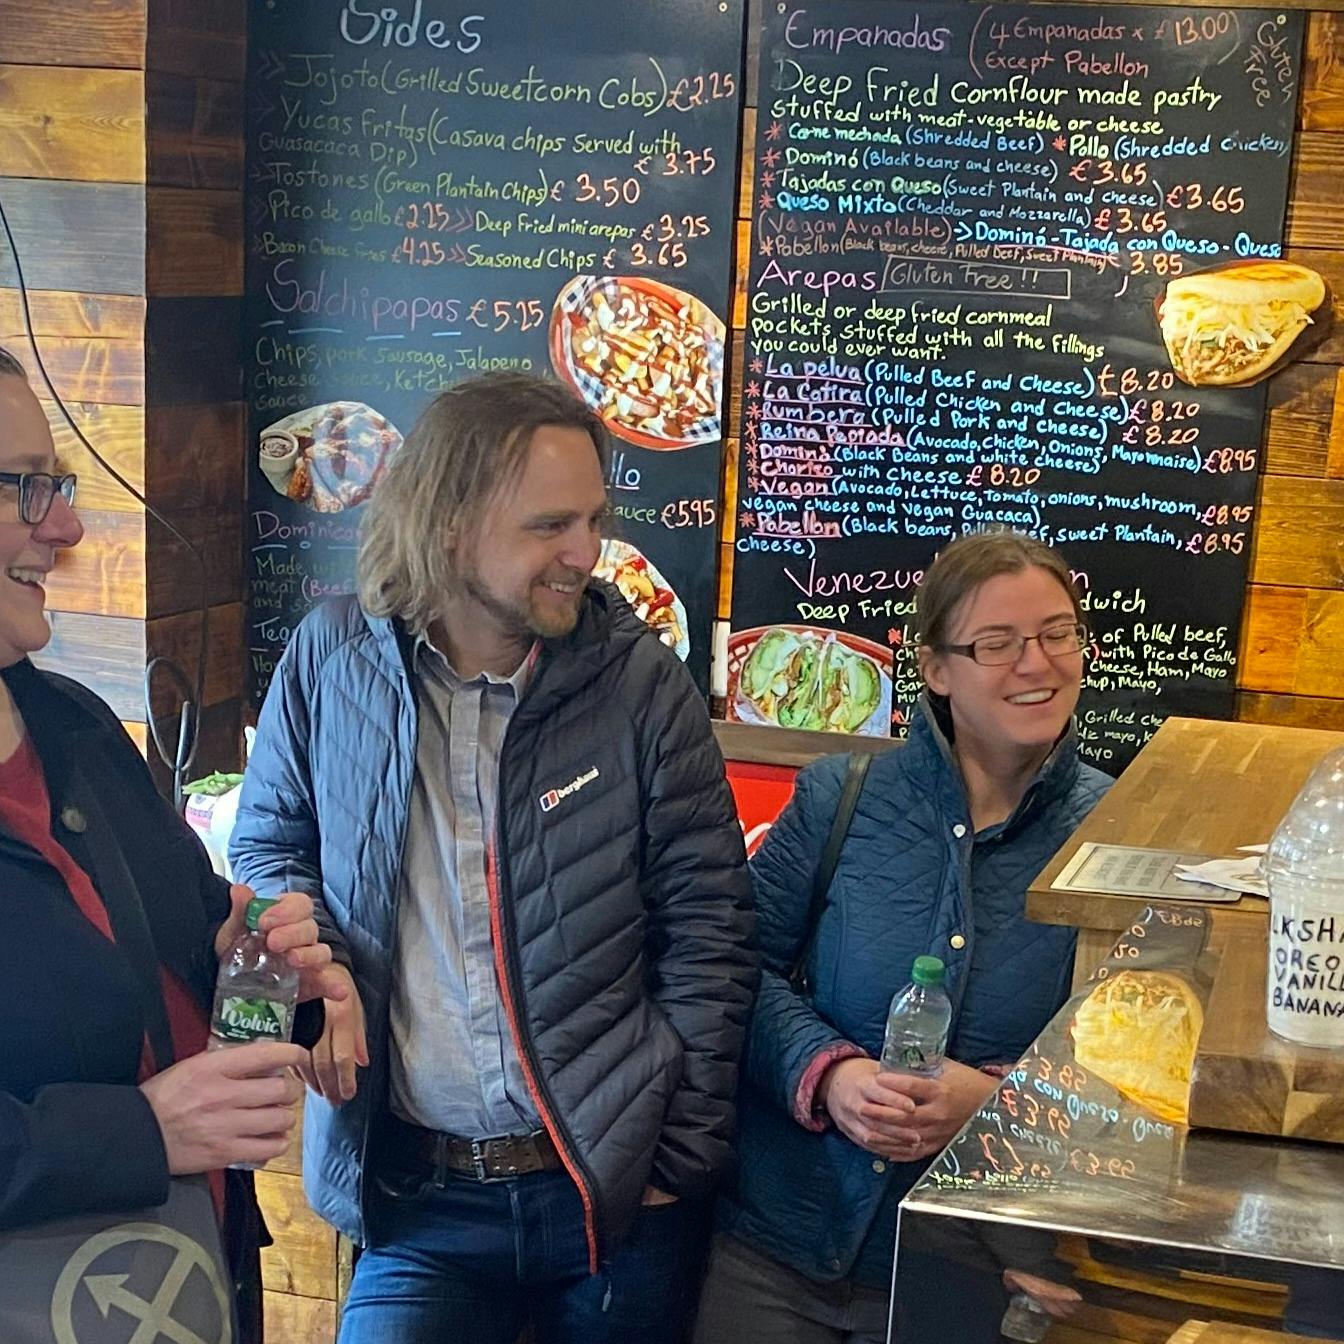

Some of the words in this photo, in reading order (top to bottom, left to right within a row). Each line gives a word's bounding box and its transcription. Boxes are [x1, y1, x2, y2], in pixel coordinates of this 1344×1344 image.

[341, 0, 485, 53] Sides
[785, 9, 951, 55] Empanadas
[1013, 16, 1126, 44] Empanadas
[985, 50, 1056, 75] Except
[1064, 50, 1149, 78] Pabellon
[284, 54, 378, 105] Jojoto
[464, 65, 591, 104] Sweetcorn
[770, 58, 853, 104] Deep
[1078, 79, 1142, 107] made
[1153, 76, 1223, 116] pastry
[281, 95, 354, 136] Yucas
[512, 126, 567, 158] chips
[639, 129, 682, 155] with
[869, 104, 912, 124] with
[1067, 118, 1094, 132] or
[1096, 115, 1165, 135] cheese
[788, 122, 832, 140] Carne
[834, 125, 903, 146] mechada
[1069, 134, 1110, 158] Pollo
[914, 152, 960, 171] beans
[965, 159, 992, 174] and
[268, 160, 369, 190] Tostones
[436, 172, 498, 199] Plantain
[775, 168, 847, 194] Tajadas
[851, 181, 886, 194] con
[889, 176, 943, 197] Queso
[1002, 182, 1057, 204] Plantain
[1064, 188, 1094, 205] and
[268, 189, 314, 222] Pico
[320, 200, 340, 222] de
[349, 201, 392, 232] gallo
[776, 191, 830, 212] Queso
[838, 196, 899, 214] Mixto
[979, 205, 1004, 219] and
[475, 210, 512, 238] Deep
[558, 218, 587, 235] mini
[589, 224, 636, 244] arepas
[1127, 238, 1159, 252] con
[1161, 230, 1220, 254] Queso
[465, 244, 548, 269] Seasoned
[547, 248, 597, 273] Chips
[756, 259, 877, 297] Arepas
[889, 261, 953, 288] Gluten
[958, 262, 1014, 290] Free
[265, 258, 462, 329] Salchipapas
[751, 292, 827, 319] Grilled
[833, 306, 857, 319] or
[863, 299, 907, 326] deep
[965, 303, 1054, 328] cornmeal
[751, 338, 784, 356] you
[788, 338, 838, 354] could
[845, 343, 886, 358] ever
[924, 328, 973, 348] with
[983, 329, 1004, 349] all
[1012, 331, 1046, 350] the
[764, 353, 794, 377] La
[981, 374, 1011, 391] and
[761, 380, 791, 400] La
[935, 392, 1002, 413] Chicken
[1010, 399, 1045, 417] and
[761, 401, 866, 426] Rumbera
[950, 408, 990, 430] Pork
[996, 415, 1028, 431] and
[760, 422, 822, 441] Reina
[945, 450, 975, 465] and
[981, 452, 1028, 466] white
[842, 465, 881, 480] with
[760, 478, 829, 500] Vegan
[742, 498, 797, 515] vegan
[804, 497, 860, 514] cheese
[867, 500, 896, 515] and
[255, 553, 307, 577] Made
[797, 602, 850, 623] Deep
[1102, 627, 1125, 644] of
[1133, 623, 1177, 645] Pulled
[1101, 645, 1135, 660] with
[1143, 644, 1175, 661] Pico
[1177, 646, 1199, 661] de
[1203, 647, 1237, 666] Gallo
[1191, 662, 1228, 679] Mayo
[1085, 708, 1136, 725] Grilled
[1276, 946, 1341, 973] OREO
[228, 1009, 280, 1034] Volvic
